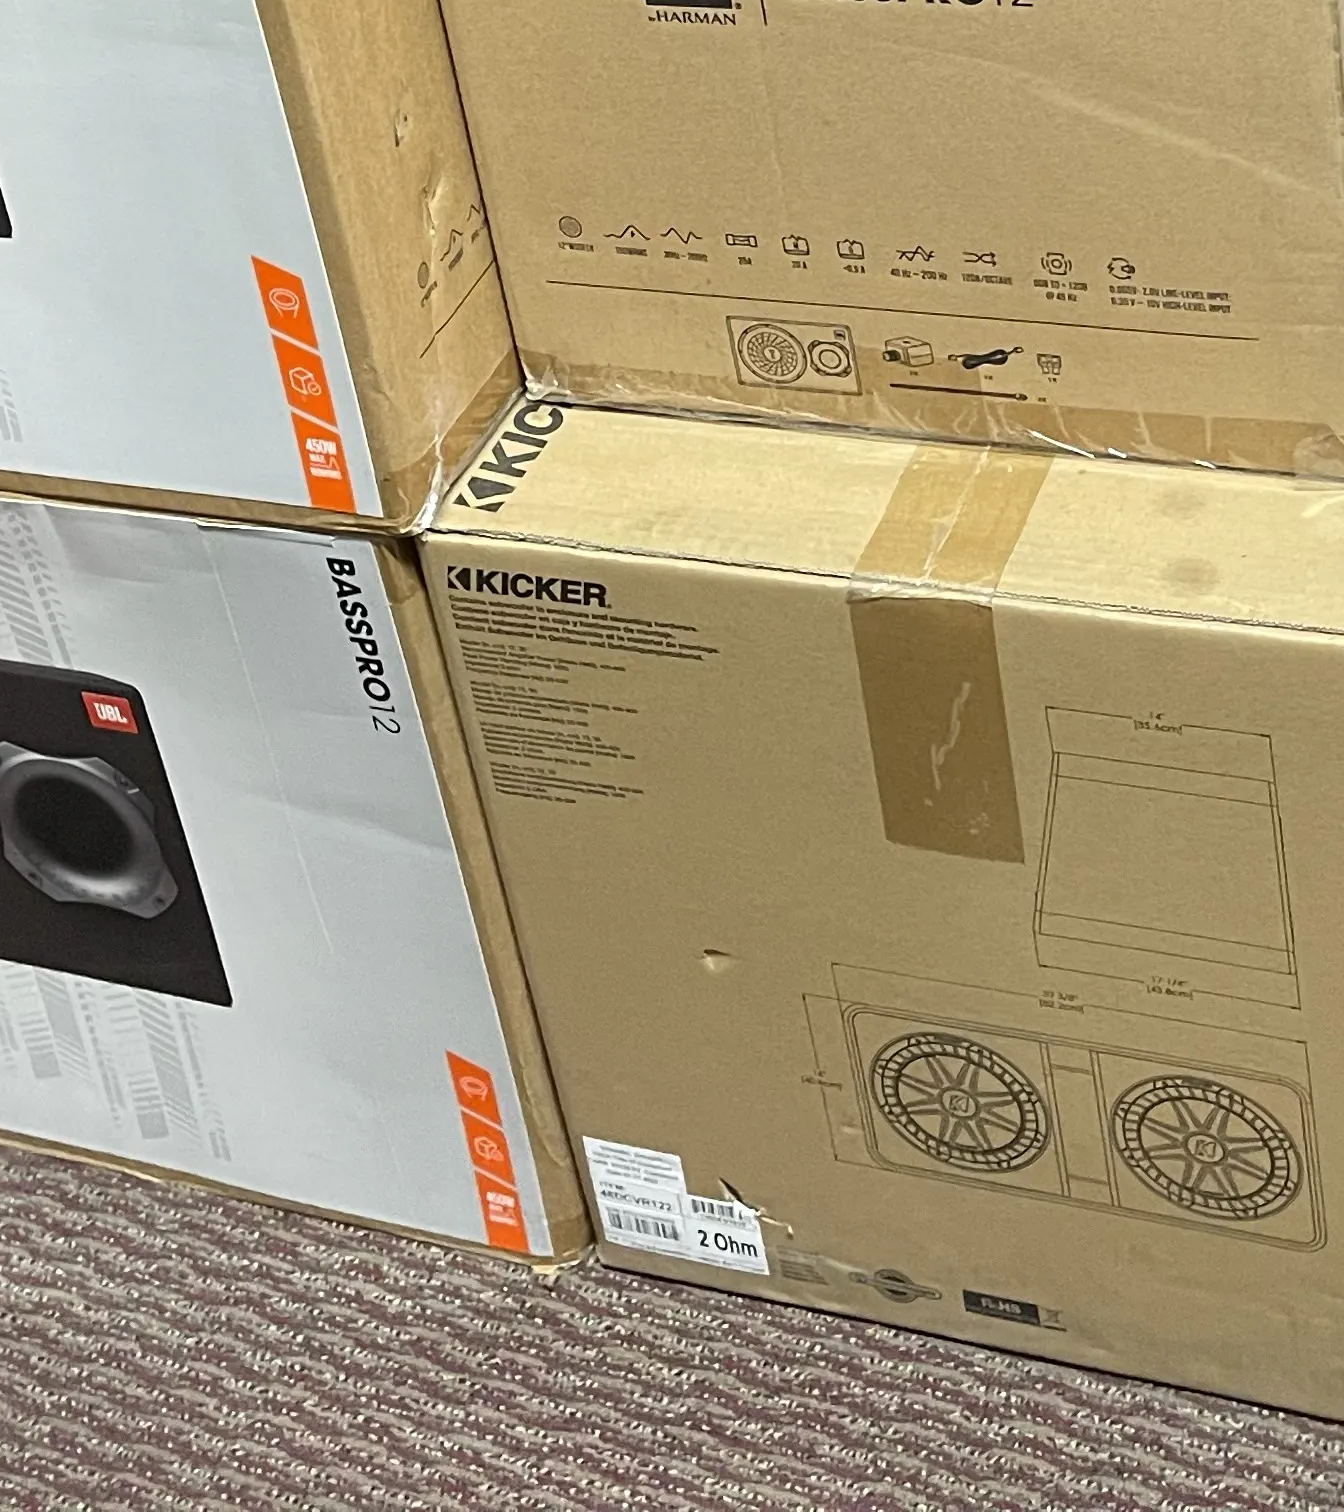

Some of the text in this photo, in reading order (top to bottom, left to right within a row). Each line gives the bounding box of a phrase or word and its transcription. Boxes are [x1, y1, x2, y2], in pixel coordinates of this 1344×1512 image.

[656, 10, 737, 26] HARMAN
[479, 401, 564, 478] KIC
[476, 569, 607, 607] KICKER
[326, 557, 401, 735] BASSPRO12
[93, 702, 128, 724] JBL
[698, 1230, 758, 1258] 2 Ohm
